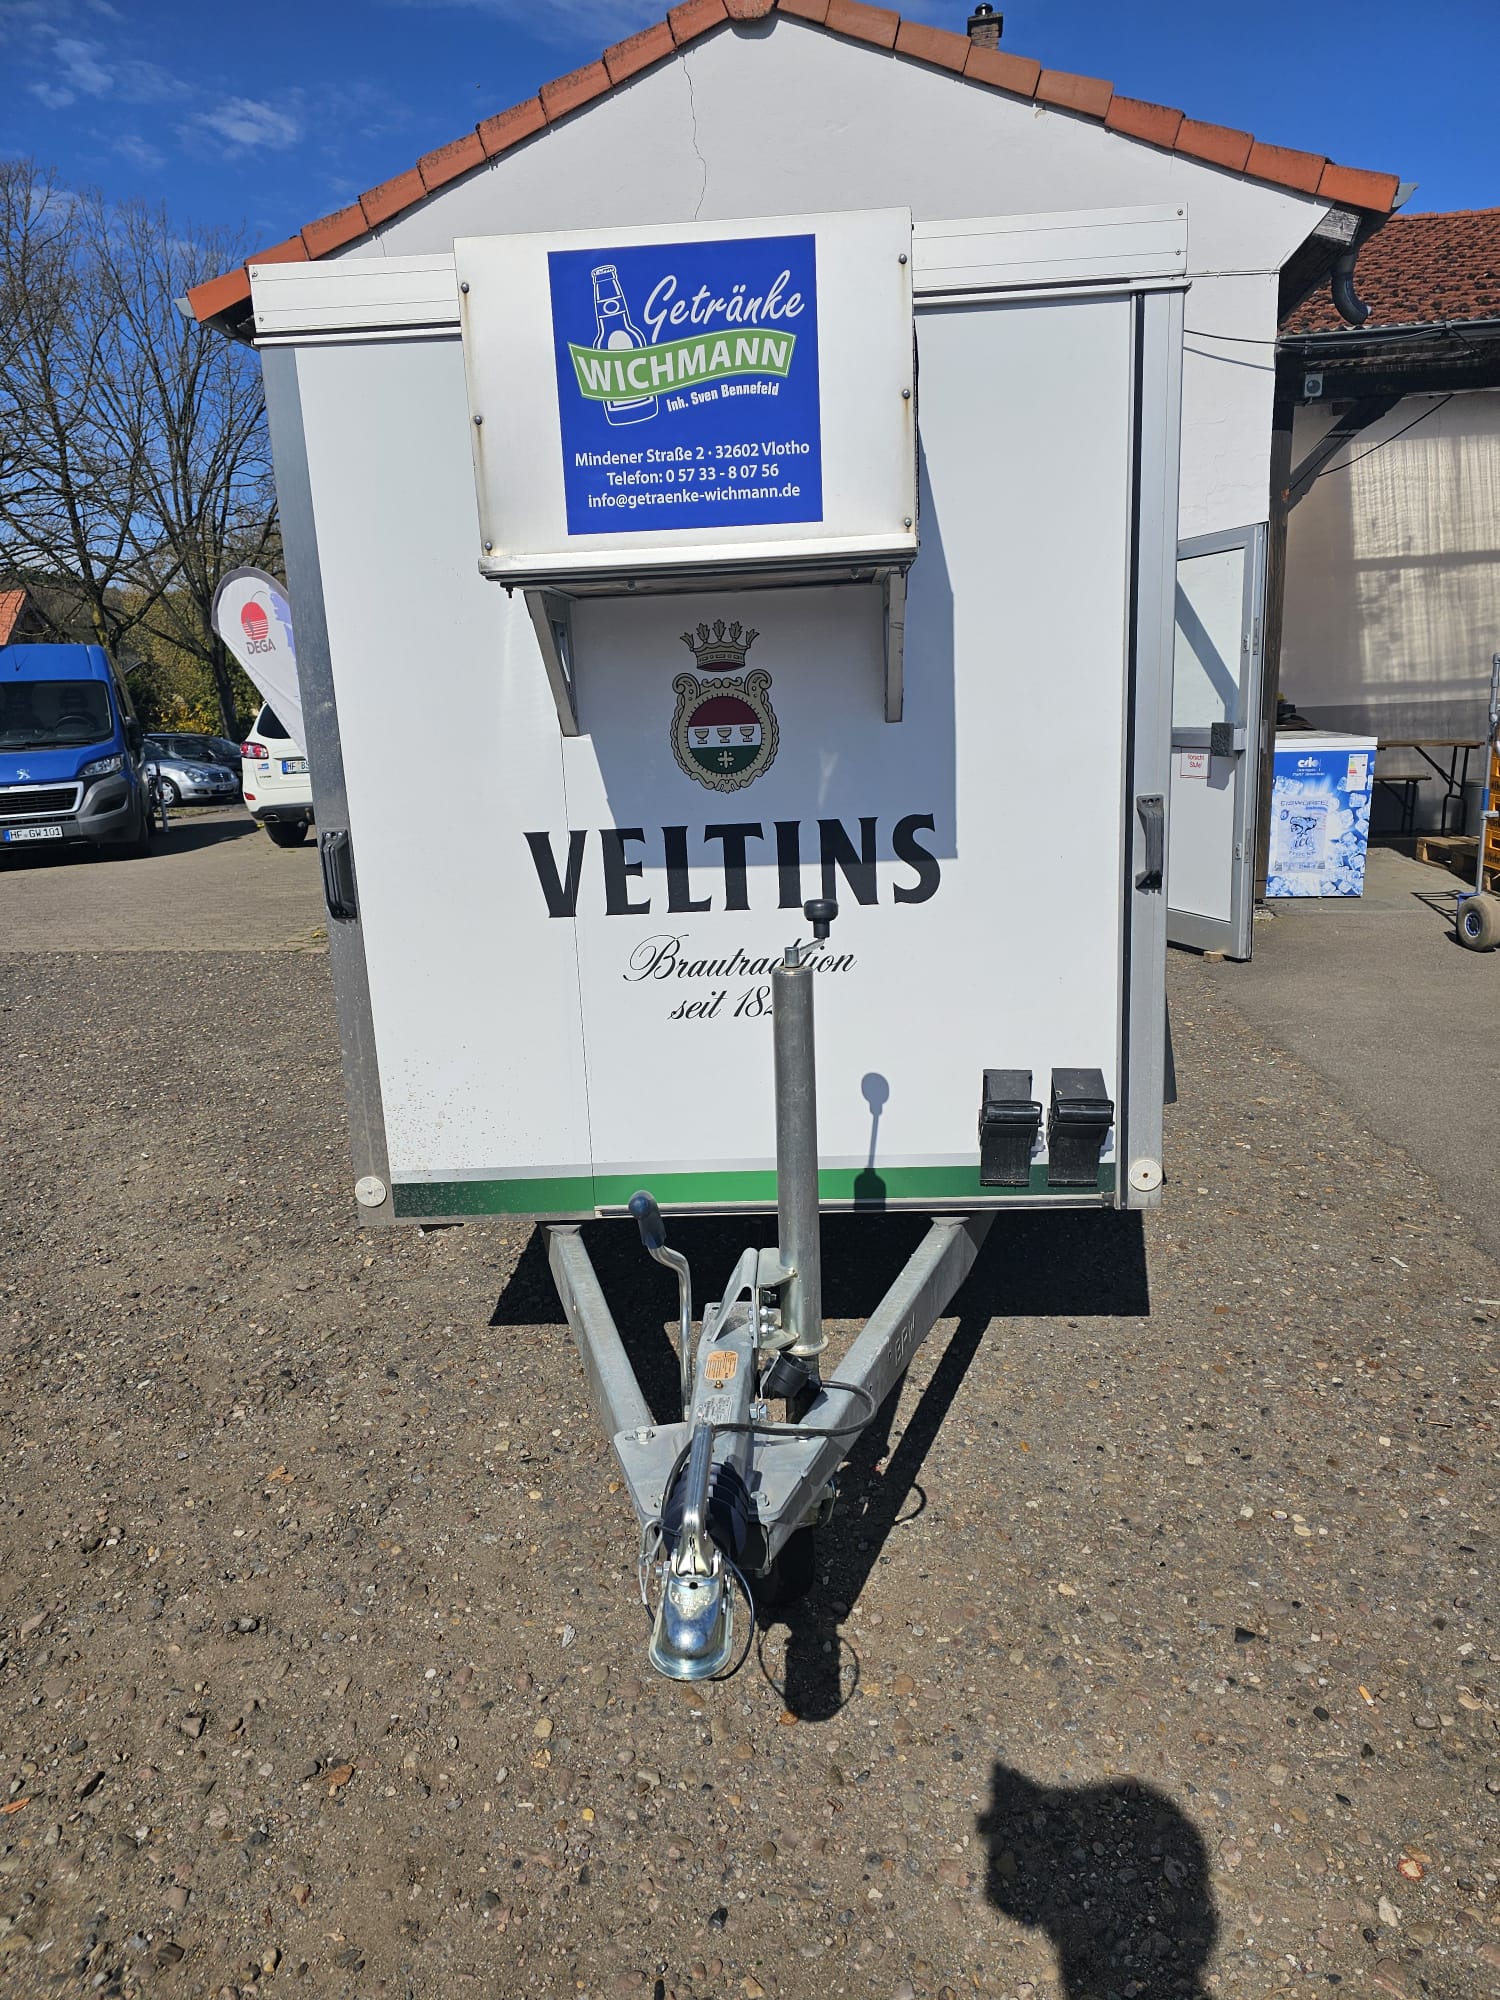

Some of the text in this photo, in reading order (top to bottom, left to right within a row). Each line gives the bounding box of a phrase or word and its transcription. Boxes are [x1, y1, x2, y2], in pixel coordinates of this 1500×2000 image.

[643, 269, 806, 344] Getränke
[576, 337, 788, 392] WICHMANN
[666, 381, 780, 412] Inh. Sven Bennefeld
[575, 451, 644, 467] Mindener
[646, 447, 693, 463] Straße
[695, 446, 705, 460] 2
[715, 444, 760, 459] 32602
[761, 440, 810, 457] Vlotho
[606, 470, 663, 486] Telefon:
[665, 469, 675, 483] 0
[678, 468, 695, 482] 57
[698, 467, 716, 480] 33
[728, 465, 737, 479] 8
[740, 465, 757, 478] 07
[761, 463, 780, 477] 56
[588, 482, 801, 509] info@getraenke-wichmann.de
[245, 638, 277, 655] DEGA
[523, 813, 941, 918] VELTINS
[666, 989, 728, 1020] seit
